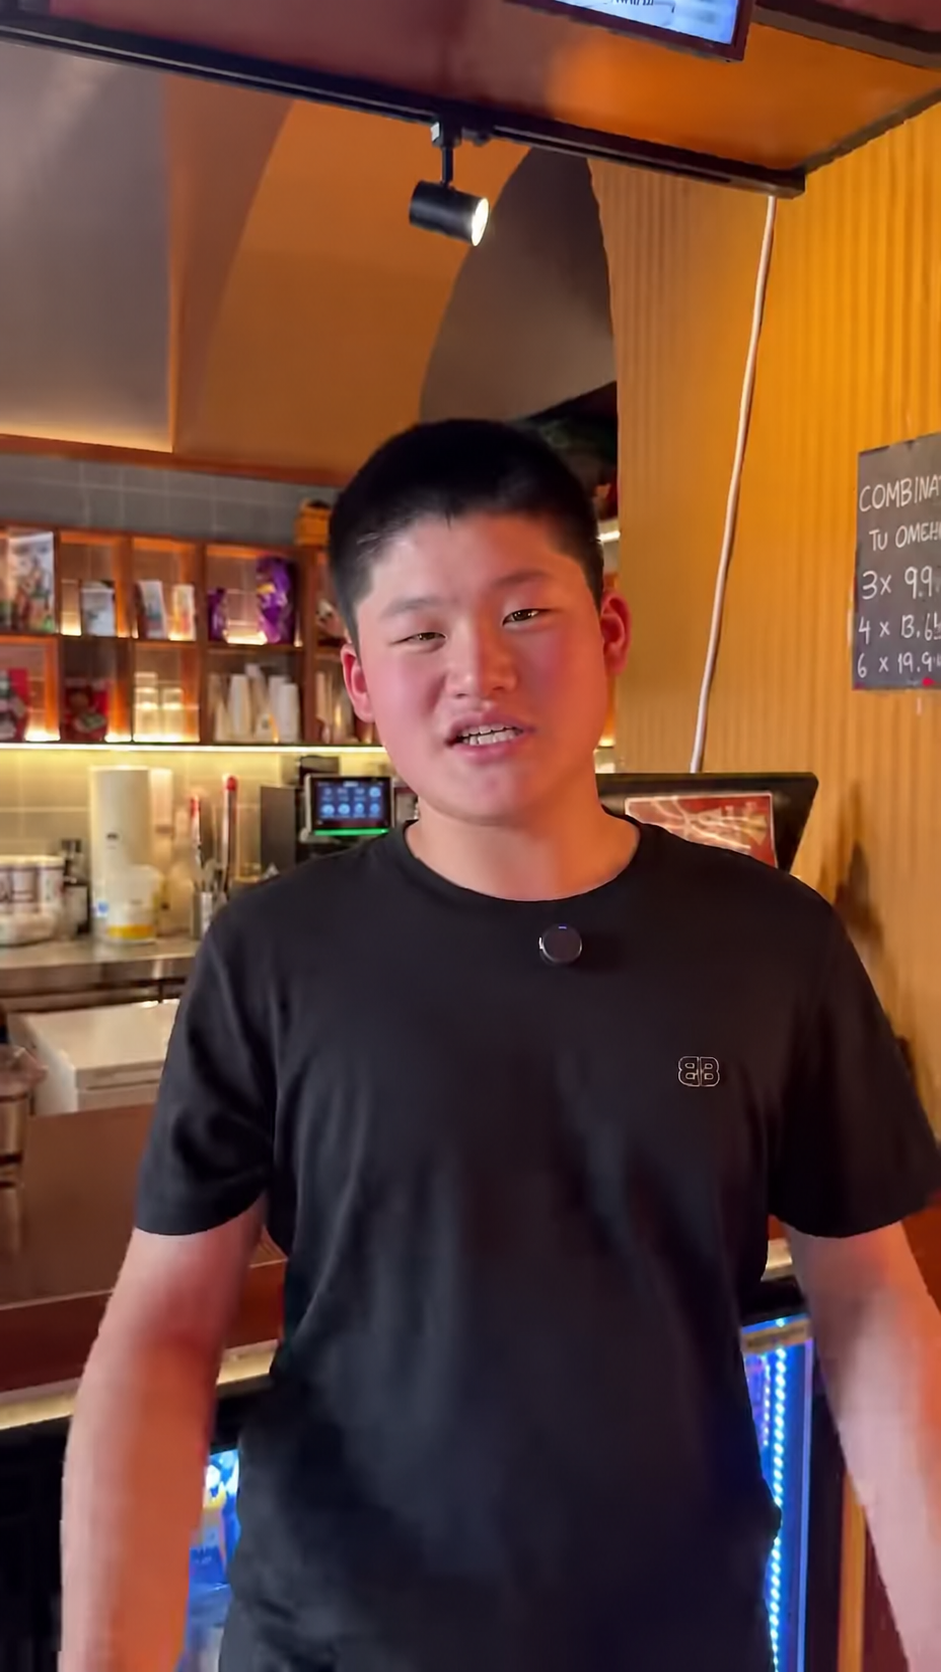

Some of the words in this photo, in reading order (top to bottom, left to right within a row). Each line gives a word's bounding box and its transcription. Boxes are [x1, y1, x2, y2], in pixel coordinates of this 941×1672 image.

[859, 474, 941, 512] COMBINA
[868, 528, 888, 551] TU
[858, 616, 870, 645] 4
[857, 652, 867, 678] 6
